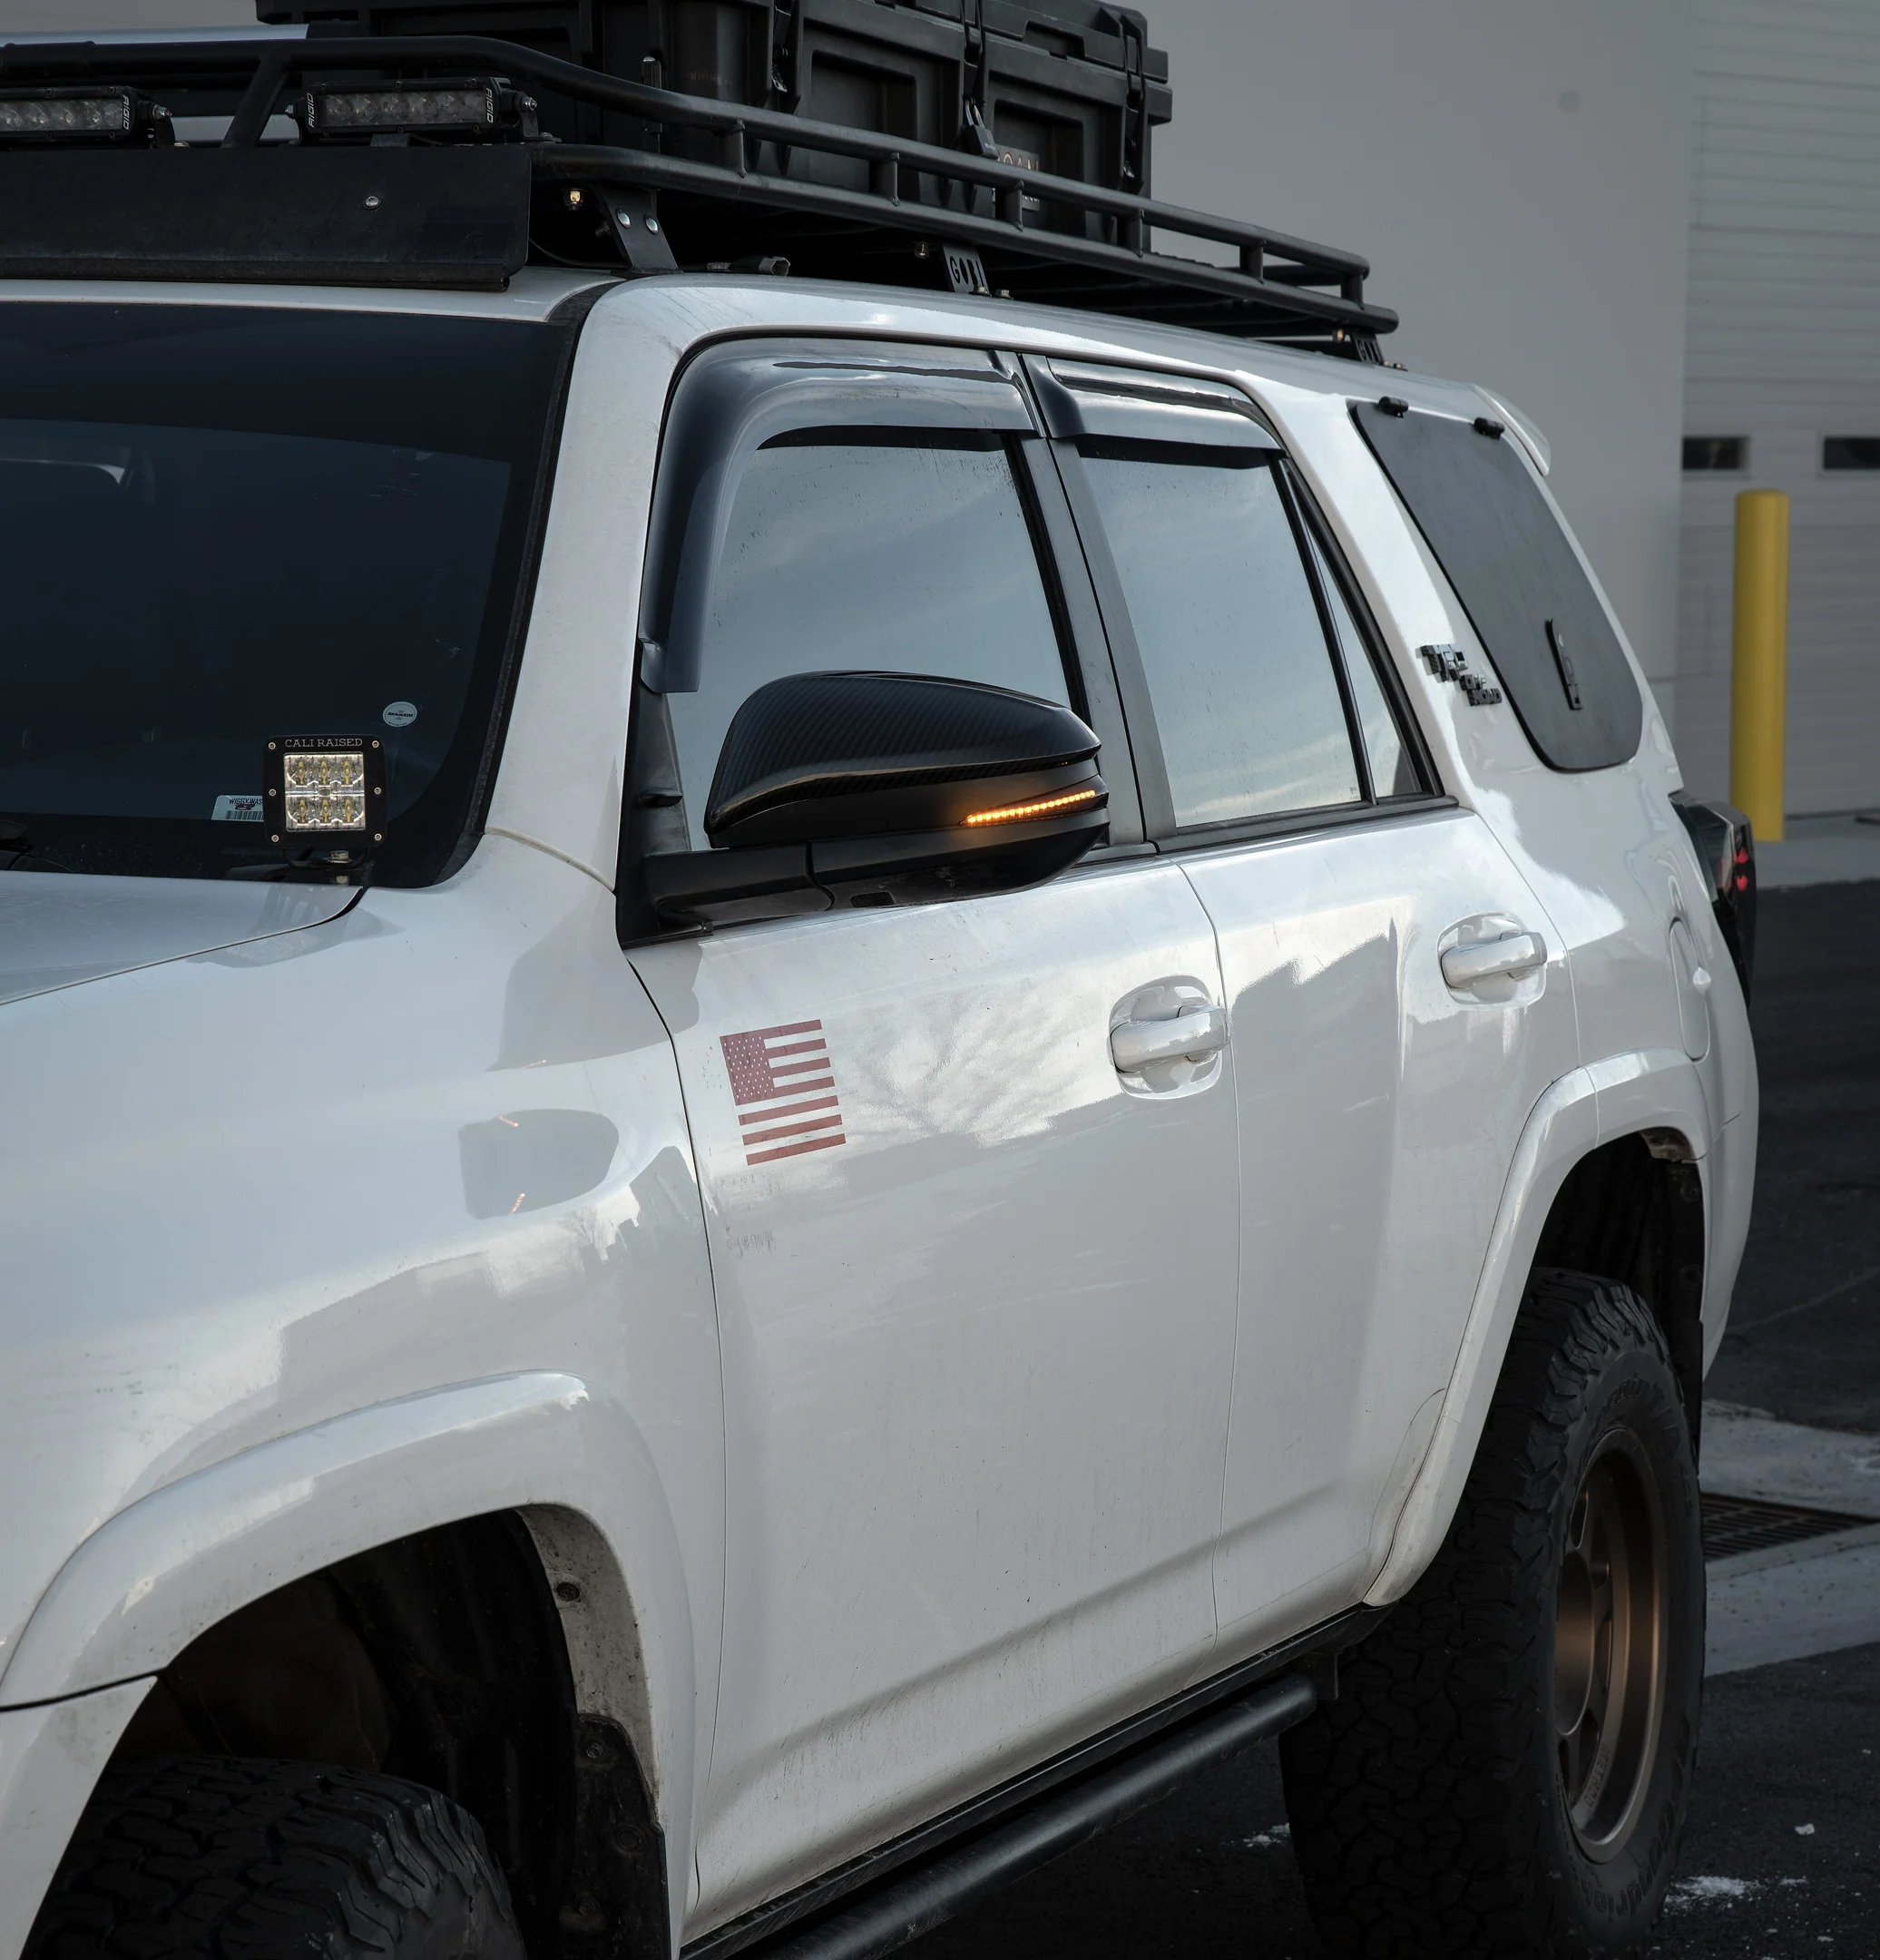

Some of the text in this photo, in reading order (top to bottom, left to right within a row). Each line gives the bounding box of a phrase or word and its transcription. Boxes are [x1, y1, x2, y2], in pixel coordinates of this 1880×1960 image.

[122, 94, 130, 131] RIGID
[306, 92, 315, 128] RIGID
[485, 87, 494, 123] RIGID
[949, 255, 985, 288] GOBI
[284, 738, 363, 748] CALI RAISED
